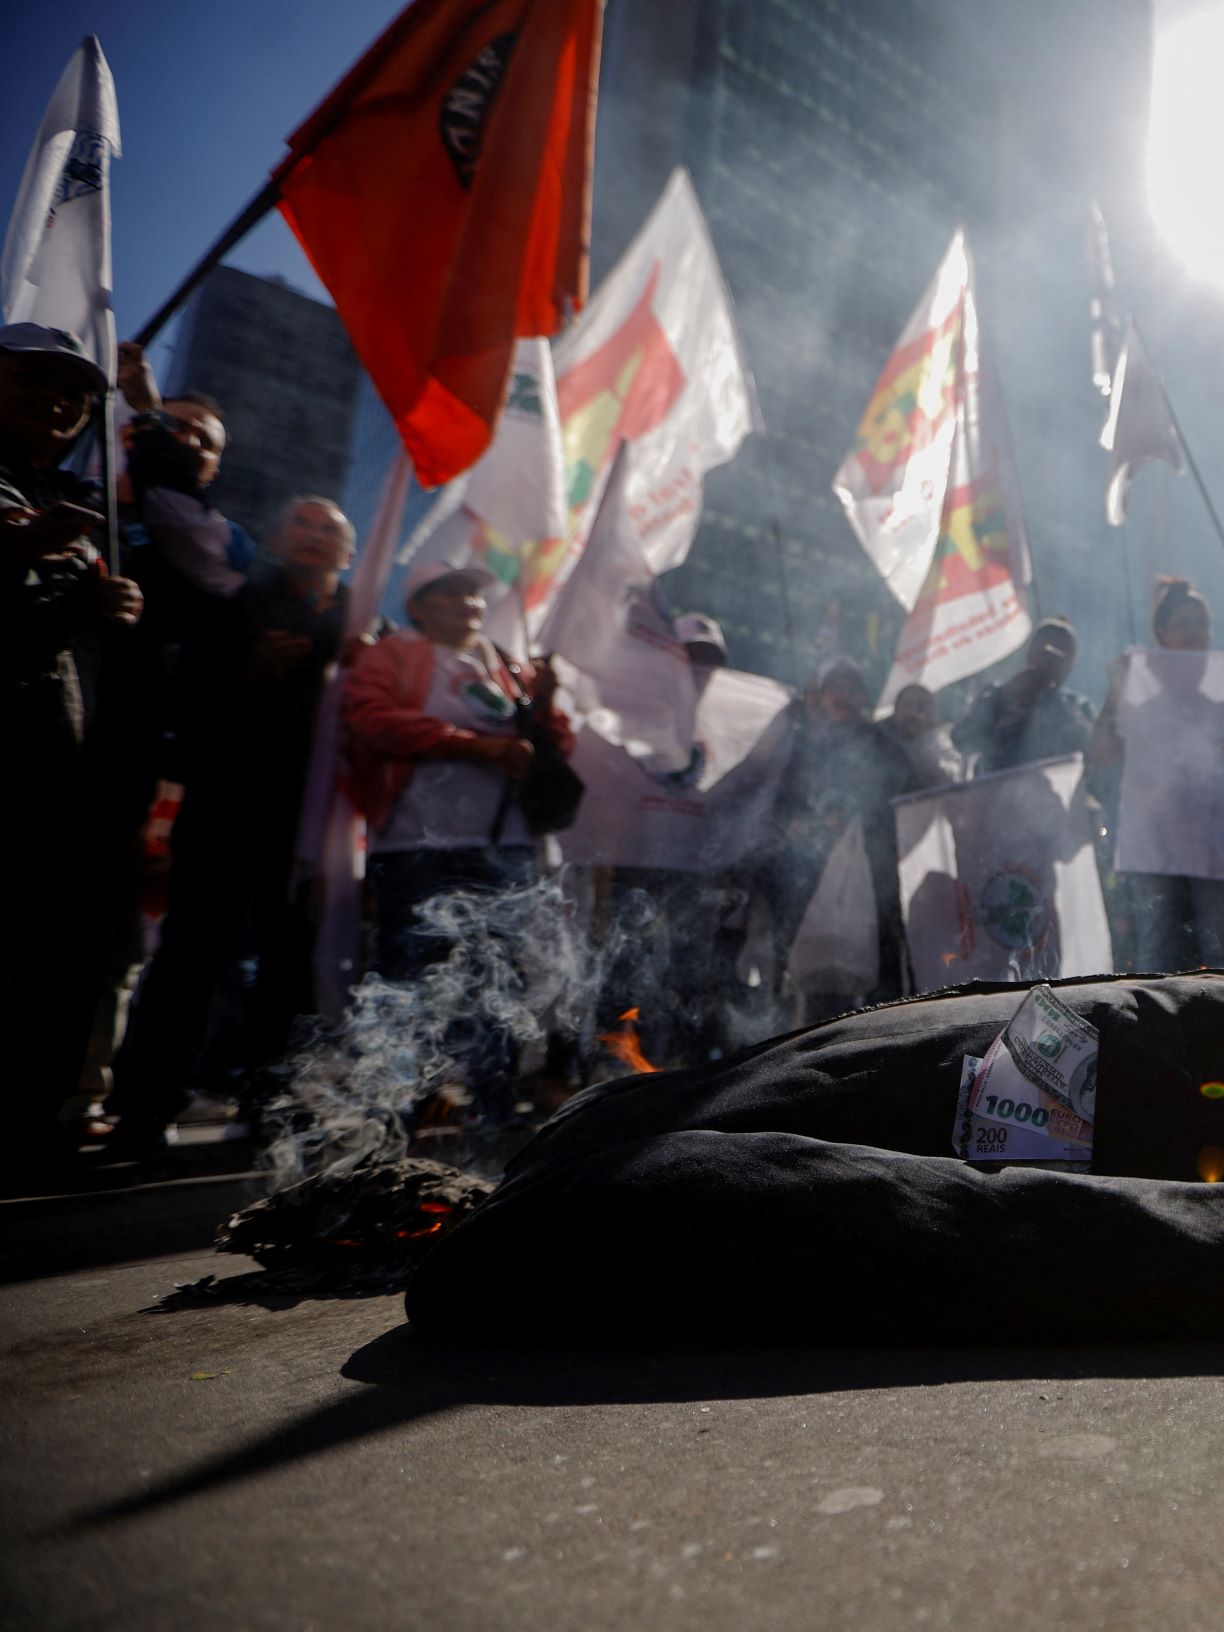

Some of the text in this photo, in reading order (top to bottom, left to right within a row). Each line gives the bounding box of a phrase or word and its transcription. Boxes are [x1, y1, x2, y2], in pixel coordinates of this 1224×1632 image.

[985, 1095, 1050, 1128] 1000
[976, 1127, 1008, 1143] 200
[976, 1144, 1006, 1153] REAIS
